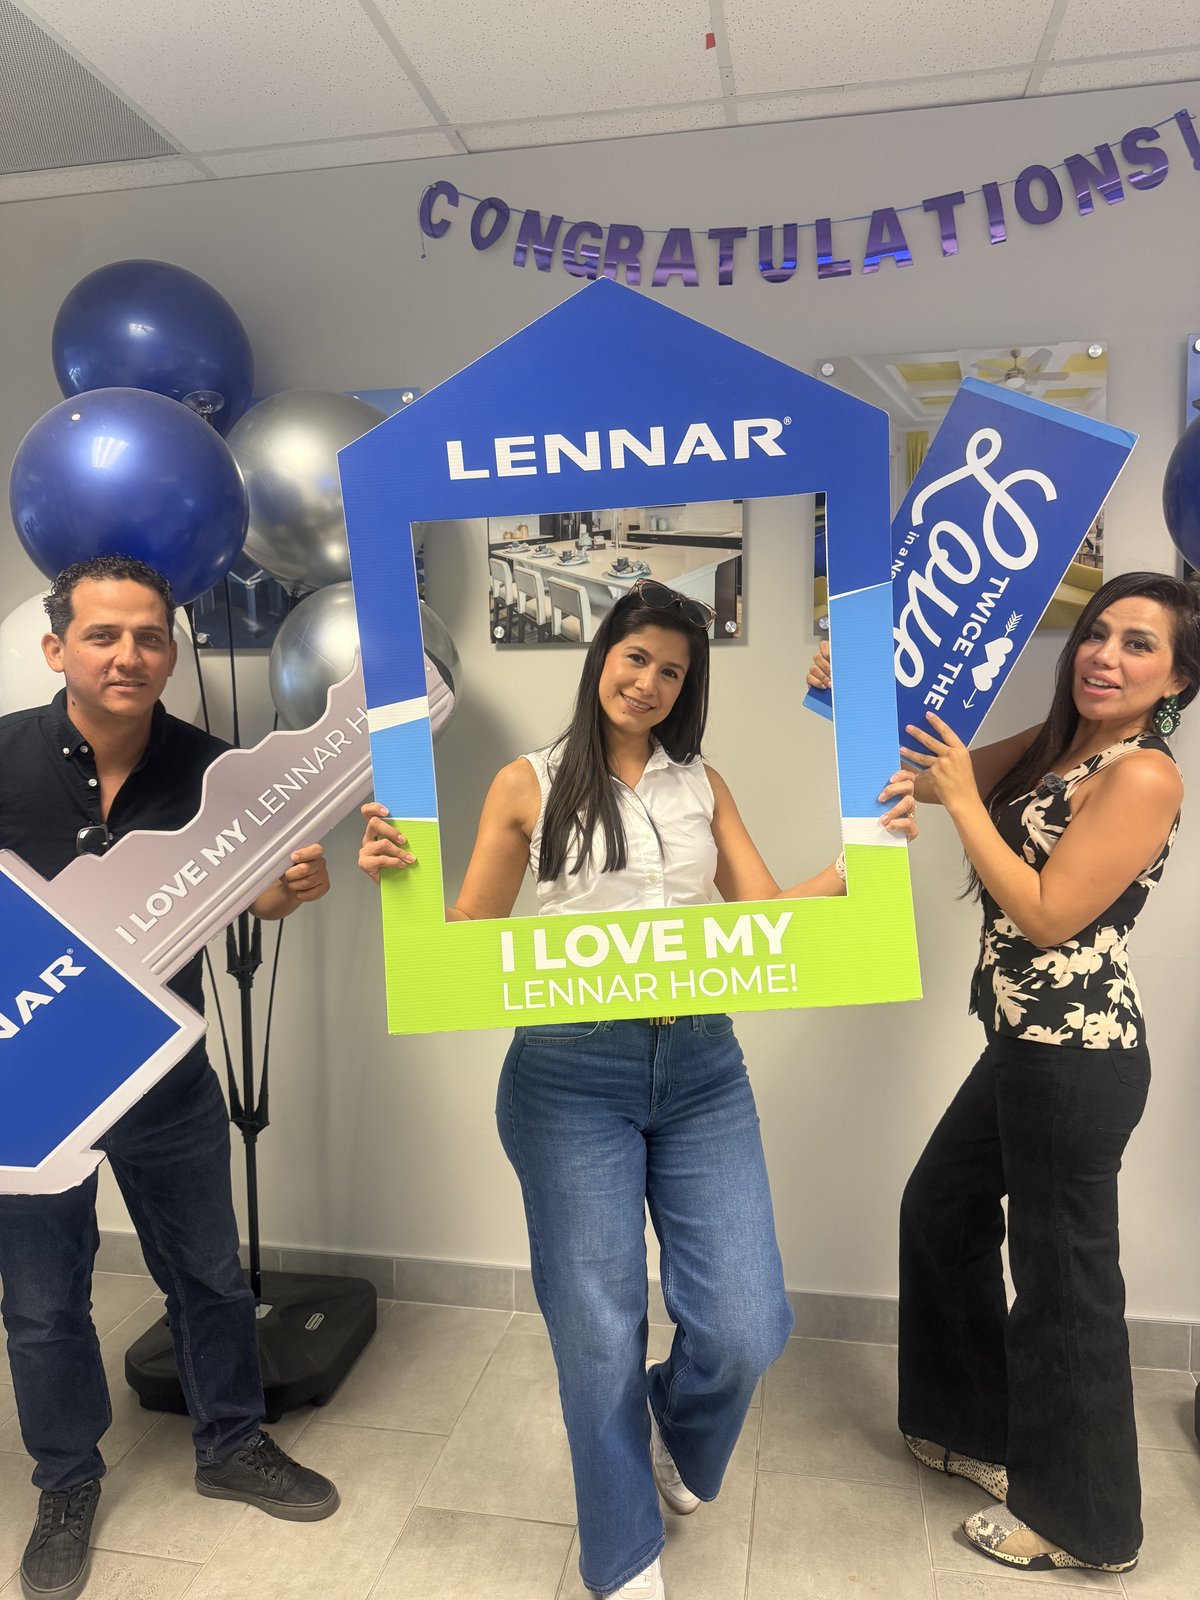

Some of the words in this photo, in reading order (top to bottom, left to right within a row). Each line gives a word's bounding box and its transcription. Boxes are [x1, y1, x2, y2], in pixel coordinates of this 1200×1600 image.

[419, 107, 1200, 287] CONGRATULATIONS!
[898, 547, 909, 557] a
[904, 530, 920, 545] in
[951, 576, 1011, 658] TWICE
[923, 662, 964, 711] THE
[114, 925, 138, 946] I
[128, 859, 209, 933] LOVE
[200, 818, 248, 867] MY
[244, 729, 353, 827] LENNAR
[500, 930, 516, 973] I
[533, 919, 688, 971] LOVE
[703, 911, 795, 959] MY
[502, 972, 658, 1011] LENNAR
[669, 963, 799, 999] HOME!
